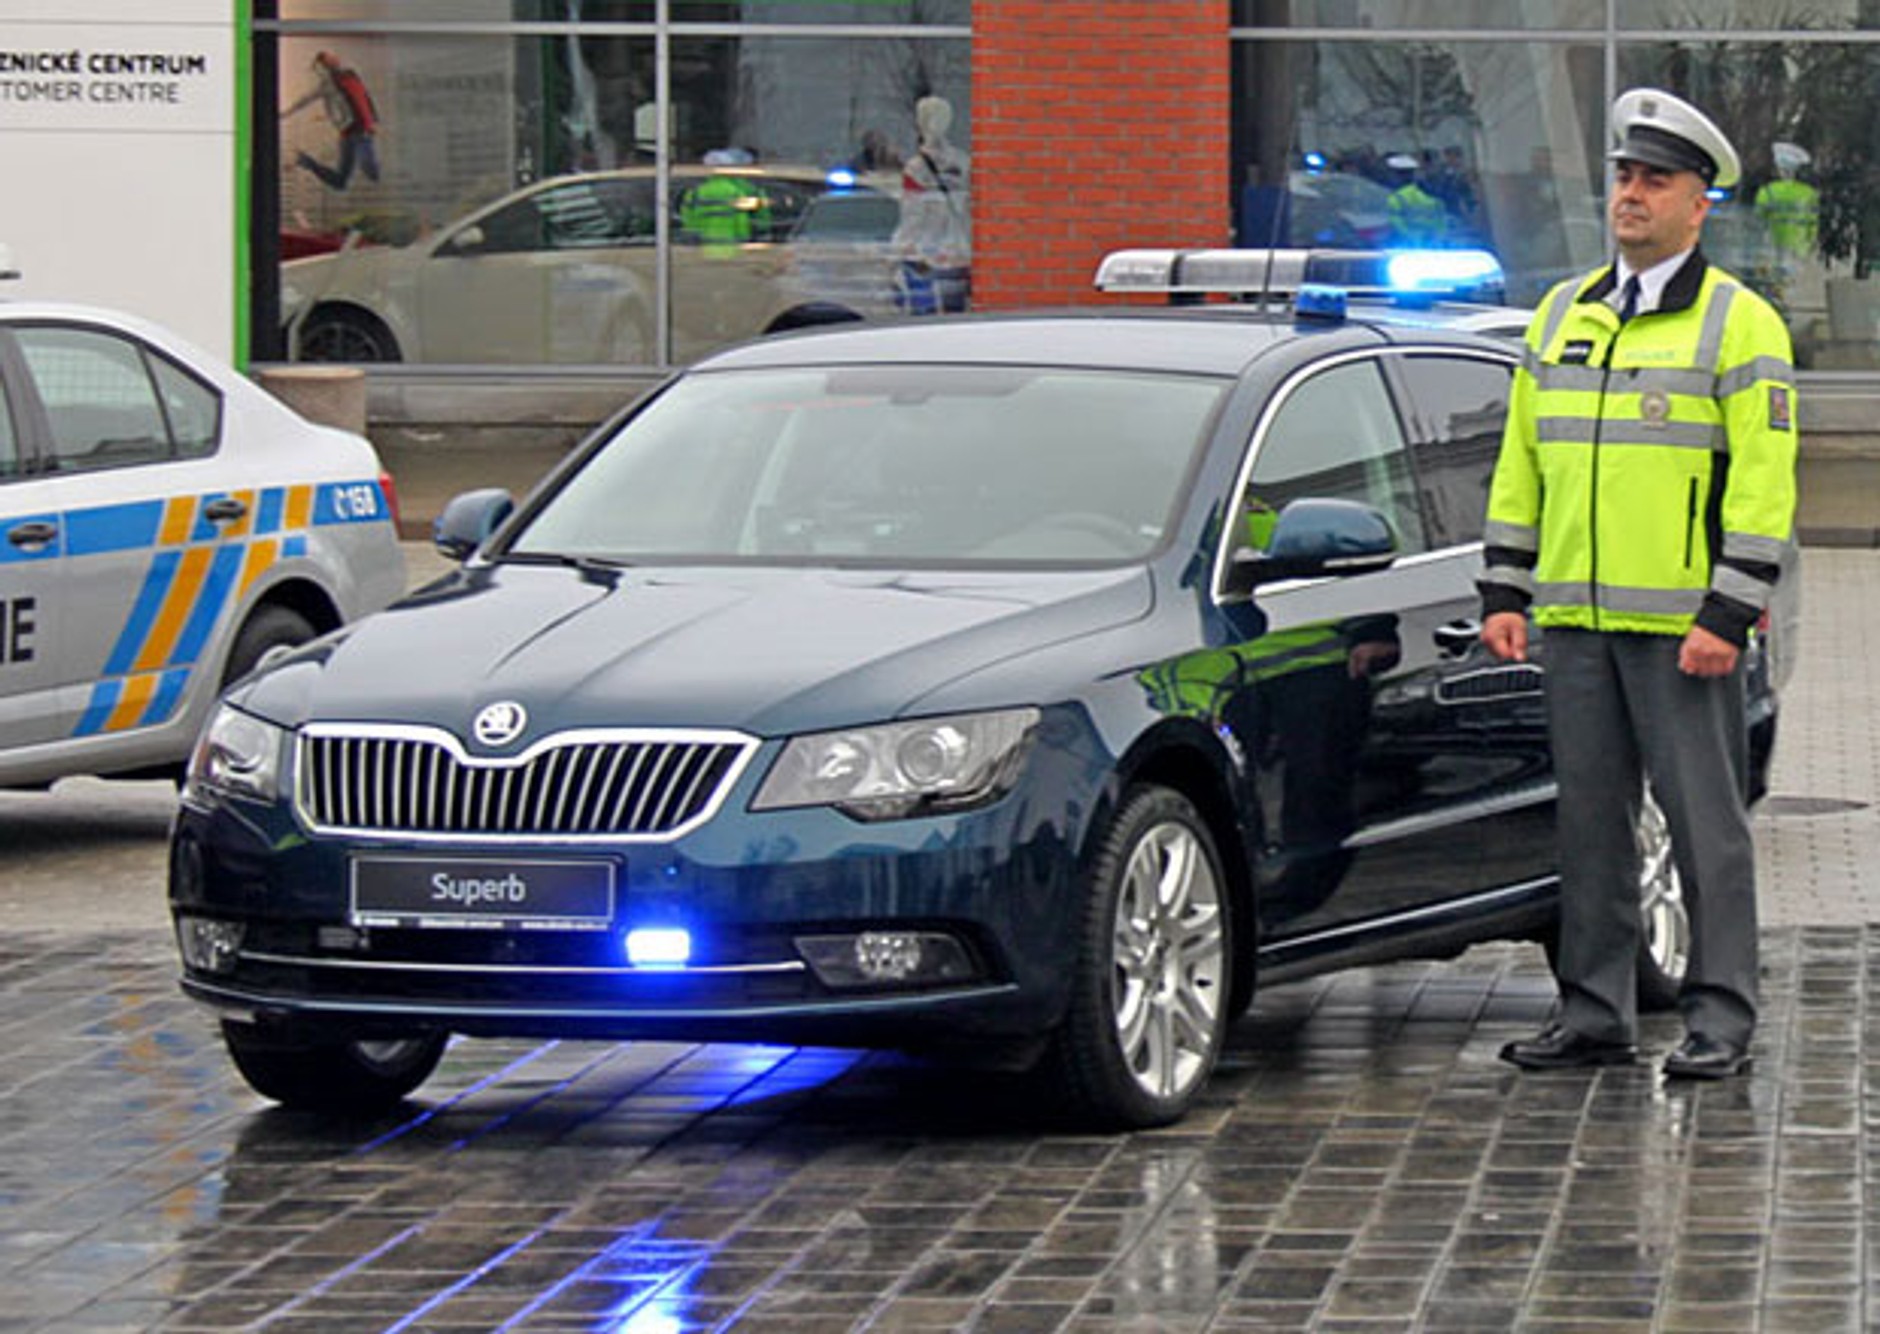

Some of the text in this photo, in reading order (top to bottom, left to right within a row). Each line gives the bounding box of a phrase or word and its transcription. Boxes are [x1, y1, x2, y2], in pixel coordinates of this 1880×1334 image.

[88, 53, 207, 75] CENTRUM
[0, 80, 181, 103] TOMER CENTRE
[431, 872, 526, 906] Superb
